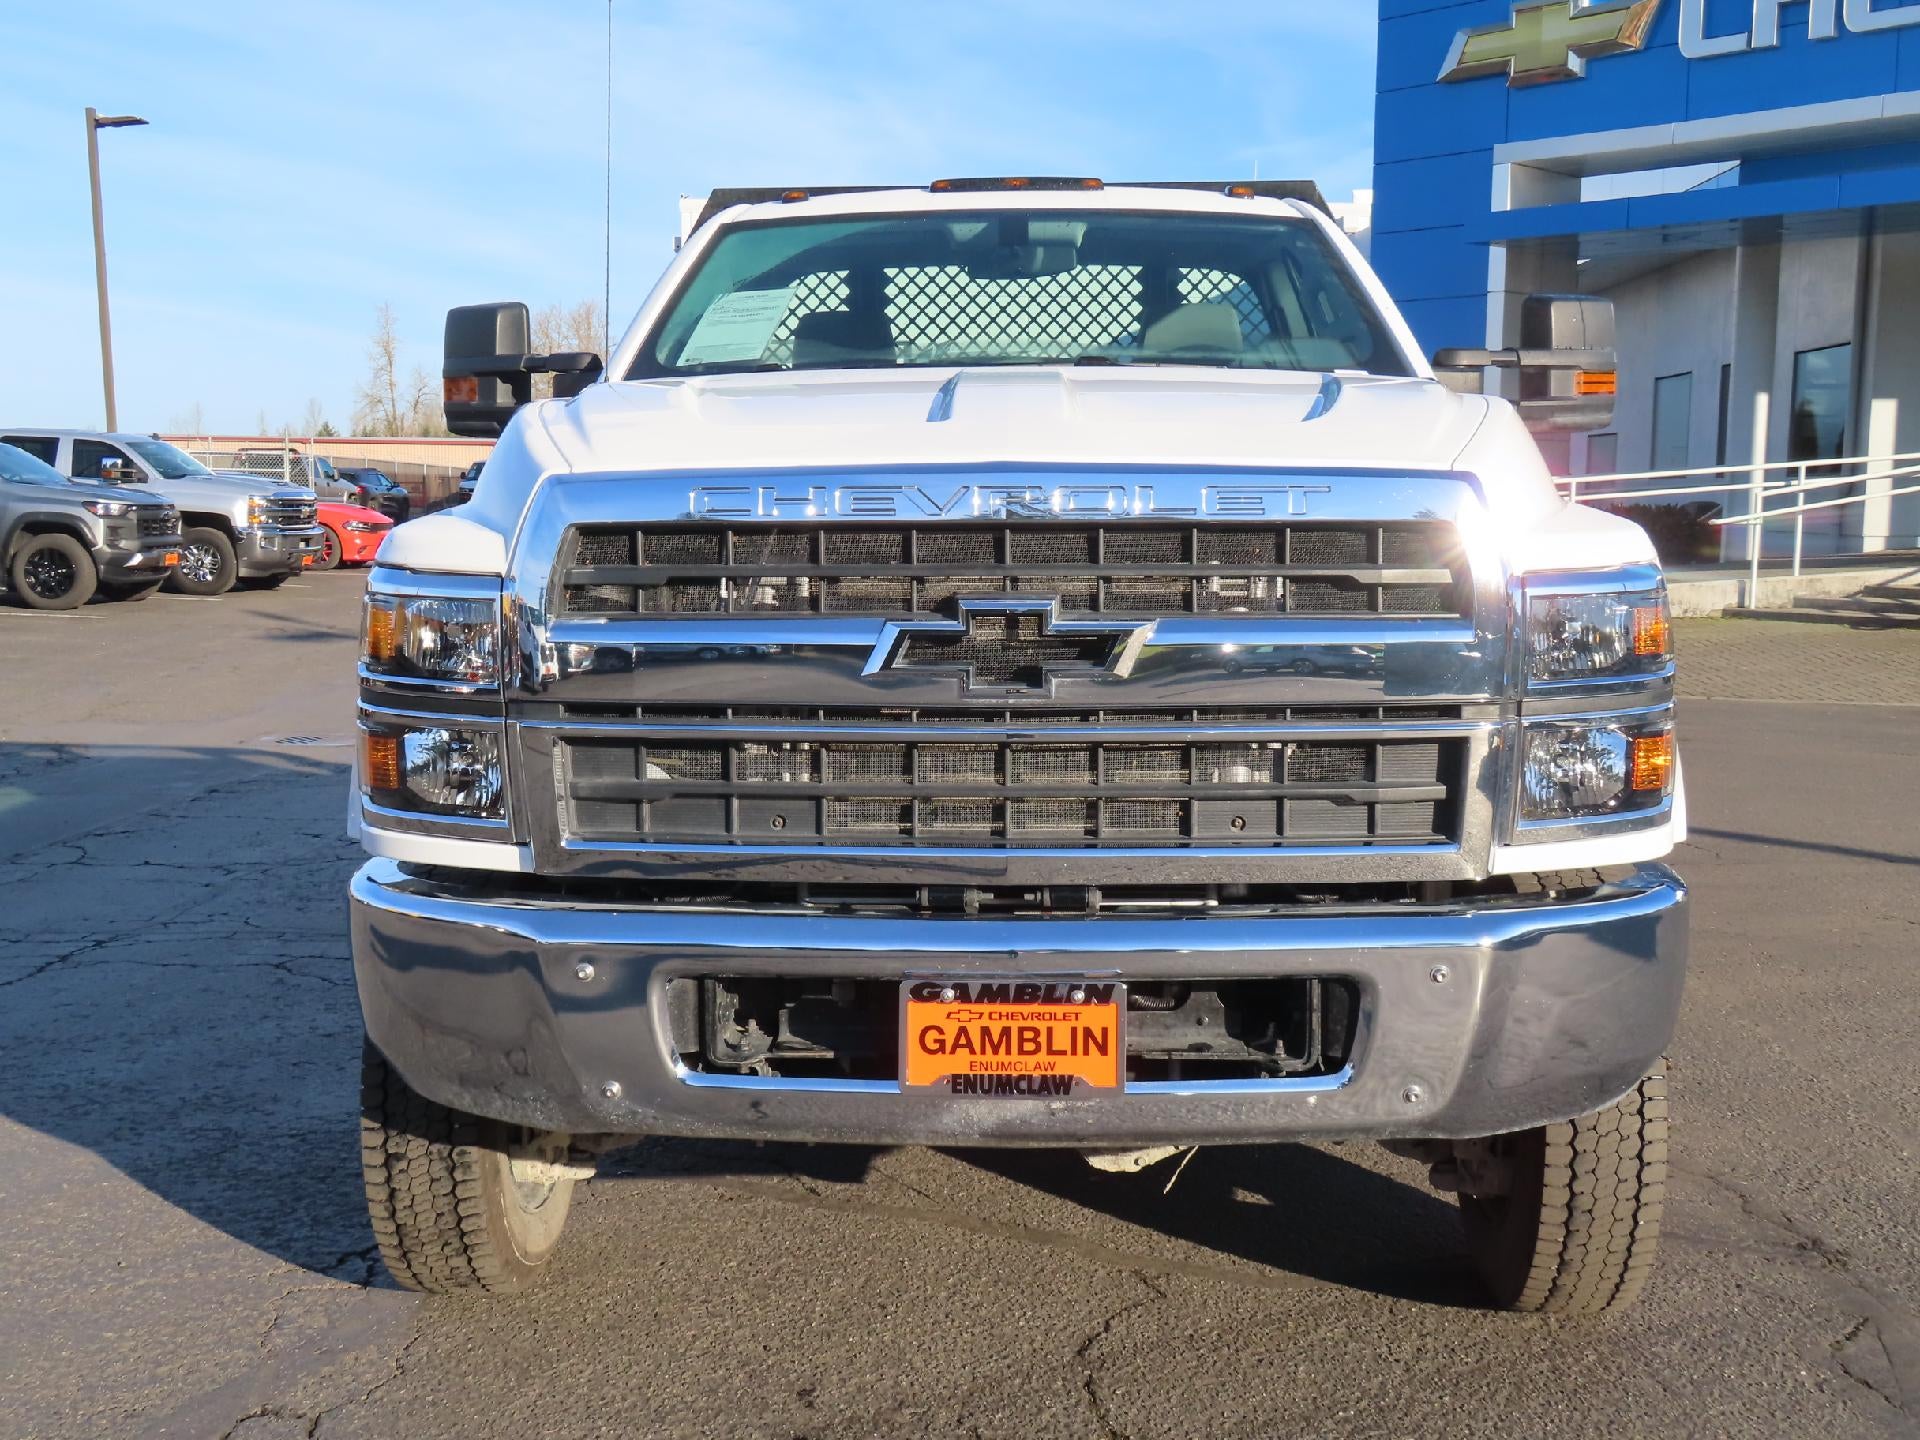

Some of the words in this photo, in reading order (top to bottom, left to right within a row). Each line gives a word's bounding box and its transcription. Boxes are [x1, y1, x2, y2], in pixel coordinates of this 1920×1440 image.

[688, 485, 1332, 517] CHEVROLET
[909, 982, 1115, 1004] GAMBLIN
[988, 1011, 1081, 1021] CHEVROLET
[918, 1025, 1108, 1056] GAMBLIN
[969, 1060, 1056, 1073] ENUMCLAW
[951, 1074, 1073, 1095] ENUMCLAW
